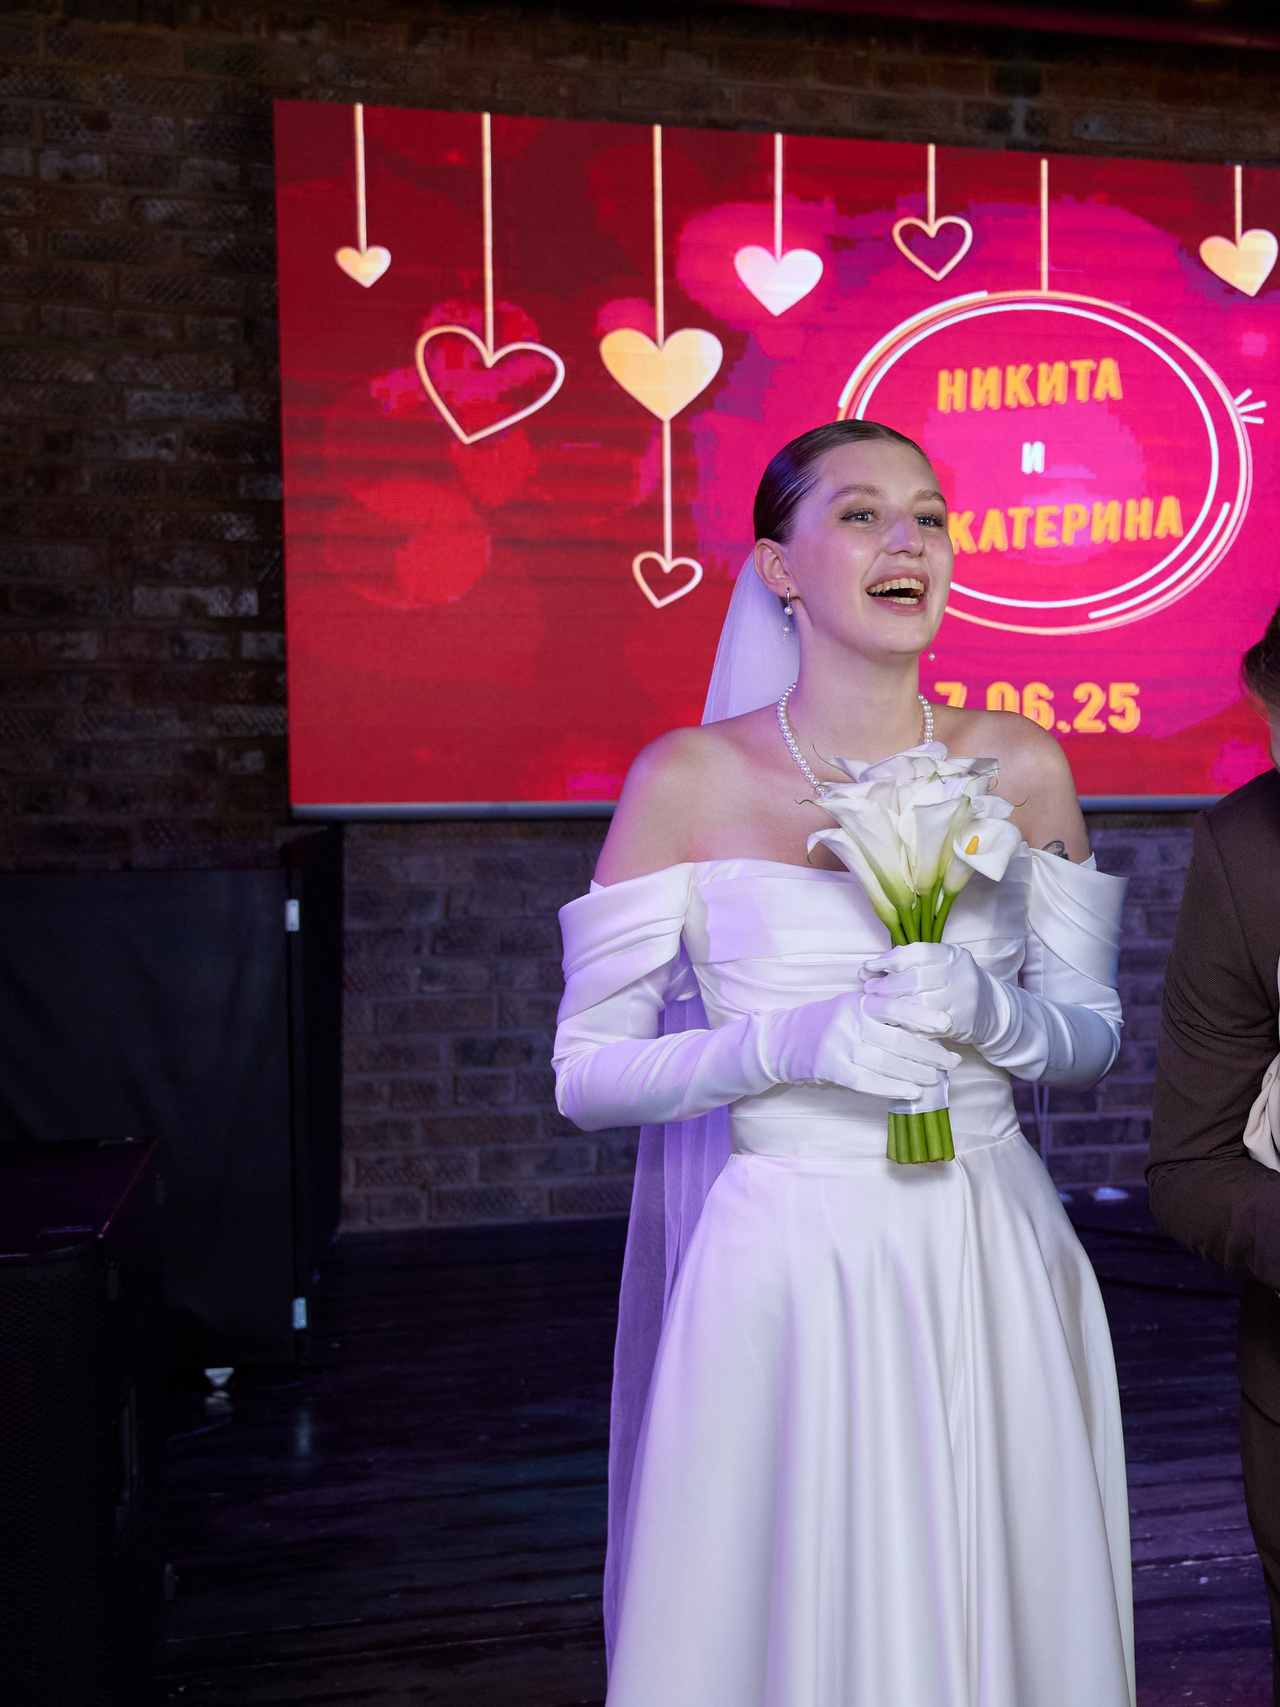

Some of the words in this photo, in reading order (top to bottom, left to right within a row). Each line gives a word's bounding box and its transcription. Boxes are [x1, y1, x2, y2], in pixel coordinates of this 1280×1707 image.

[937, 357, 1124, 414] НИКИТА
[948, 495, 1184, 556] КАТЕРИНА
[933, 681, 1141, 734] 706.25
